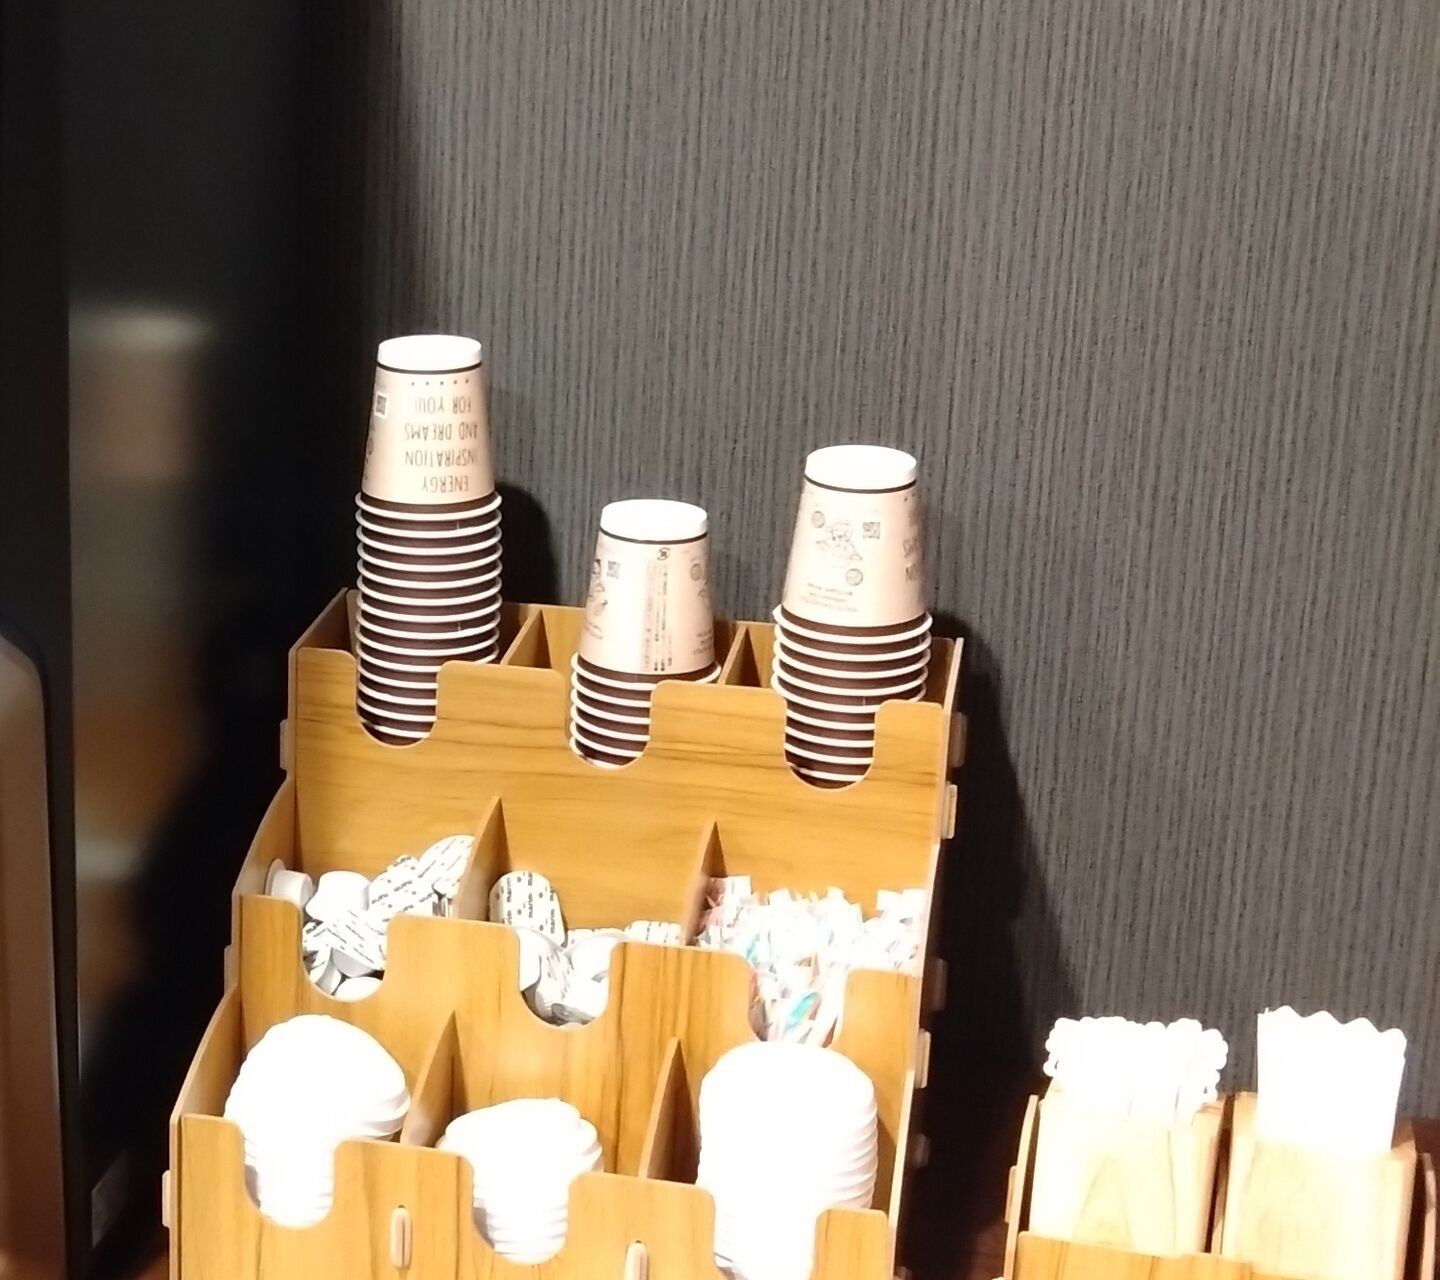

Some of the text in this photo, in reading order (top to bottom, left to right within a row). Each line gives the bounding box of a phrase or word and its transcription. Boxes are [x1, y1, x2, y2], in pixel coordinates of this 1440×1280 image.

[452, 395, 472, 414] FOR
[404, 422, 479, 440] AND DREAMS
[405, 449, 479, 467] INSPIRATION
[423, 475, 469, 493] ENERGY
